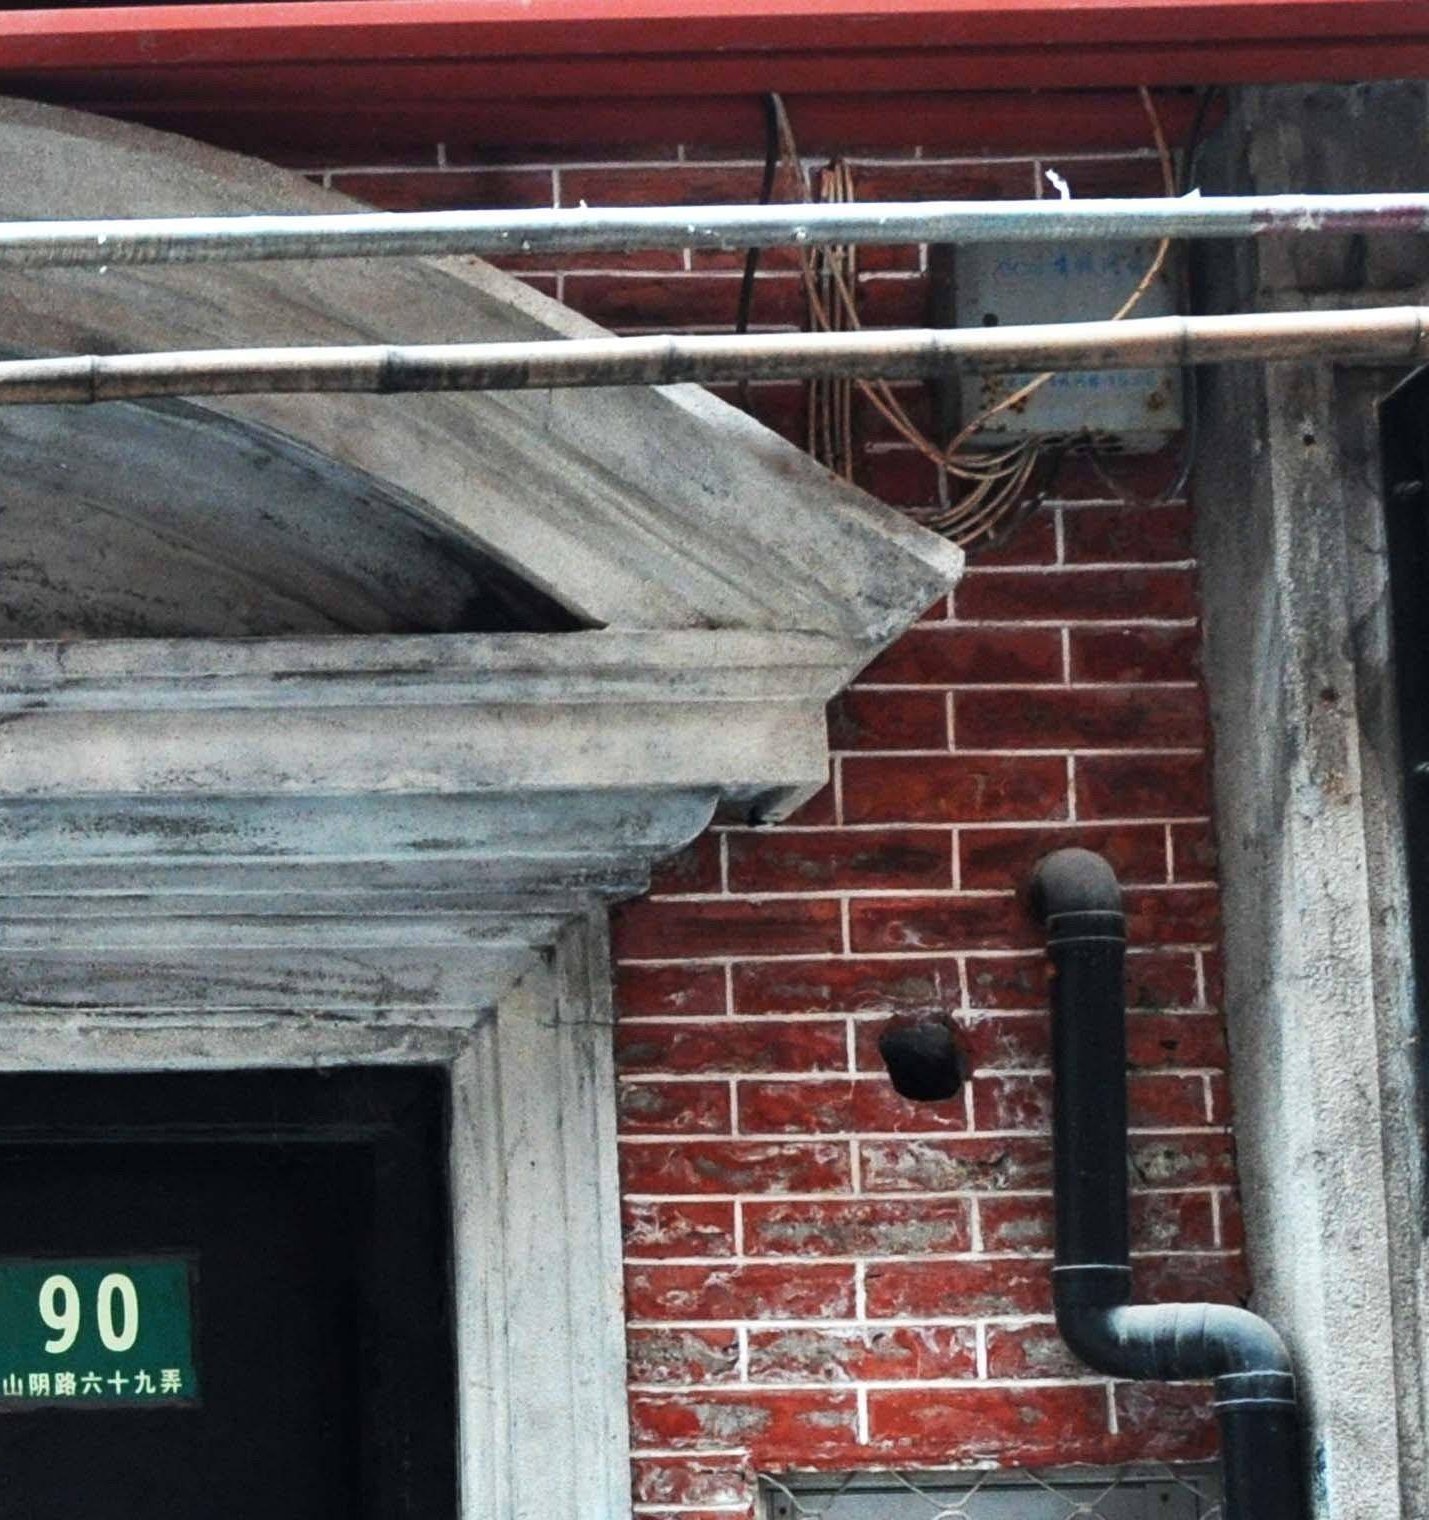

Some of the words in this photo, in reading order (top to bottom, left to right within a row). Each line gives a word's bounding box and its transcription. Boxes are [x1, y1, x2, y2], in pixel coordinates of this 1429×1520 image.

[39, 1273, 139, 1353] 90
[3, 1369, 182, 1396] 山阴路六十九弄
